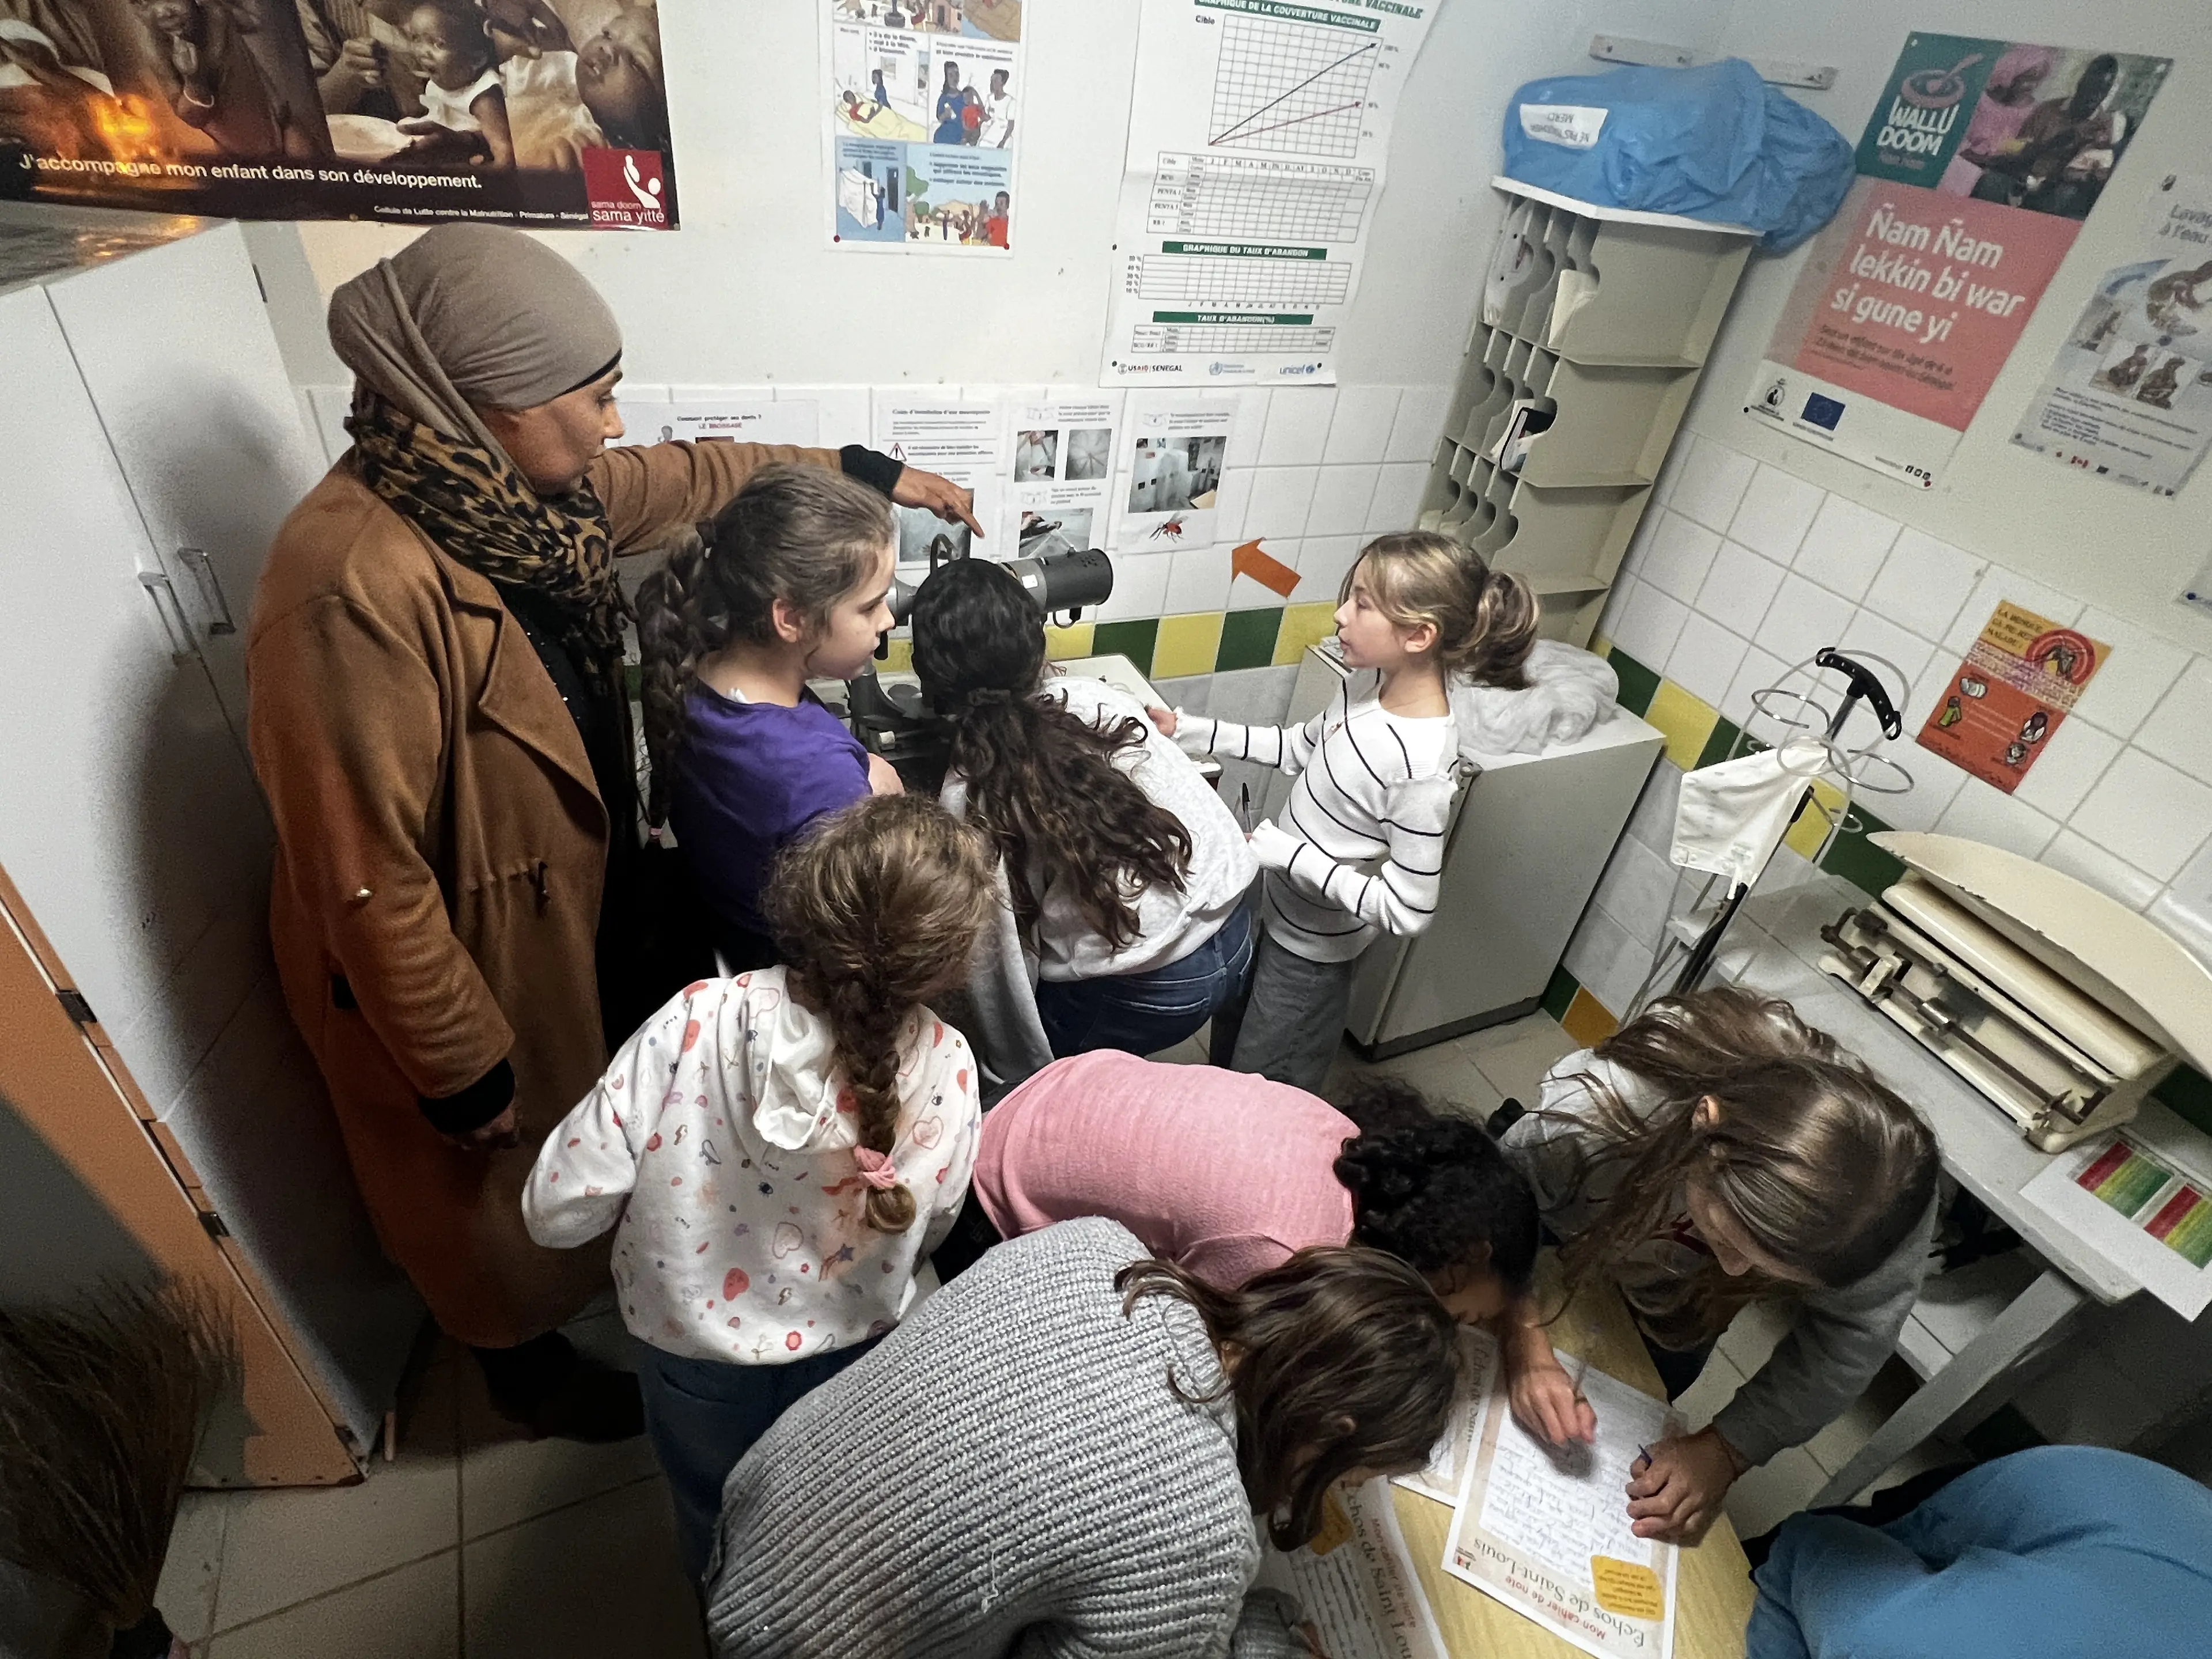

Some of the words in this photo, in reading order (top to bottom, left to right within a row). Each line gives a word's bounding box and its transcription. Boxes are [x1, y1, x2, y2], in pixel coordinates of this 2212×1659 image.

[1248, 2, 1260, 12] DE
[1261, 3, 1272, 12] LA
[1274, 5, 1328, 21] COUVERTURE
[1330, 14, 1376, 29] VACCINALE
[1888, 95, 1959, 134] WALLU
[1876, 125, 1944, 157] DOOM
[20, 153, 162, 177] J'accompagne
[165, 164, 208, 177] mon
[211, 164, 269, 180] enfant
[272, 166, 315, 180] dans
[318, 169, 350, 182] son
[353, 169, 483, 189] développement.
[591, 201, 615, 209] sama
[617, 200, 642, 210] doom
[592, 210, 632, 222] sama
[635, 207, 665, 226] yitté
[1866, 203, 1931, 251] Ñam
[1931, 218, 2004, 270] Ñam
[1183, 244, 1228, 253] GRAPHIQUE
[1229, 245, 1241, 253] DU
[1243, 247, 1263, 255] TAUX
[1264, 247, 1309, 257] D'ABANDON
[1849, 243, 1931, 293] lekkin
[1931, 265, 1969, 302] bi
[1965, 283, 2025, 317] war
[1831, 282, 1860, 313] si
[1852, 295, 1923, 334] gune
[1919, 311, 1958, 345] yi
[1152, 364, 1183, 372] SENEGAL
[1279, 364, 1305, 374] unicef
[1361, 1541, 1376, 1563] de
[1474, 1537, 1566, 1603] Saint-Louis
[1505, 1575, 1529, 1595] note
[1531, 1590, 1544, 1604] de
[1569, 1593, 1590, 1613] de
[1547, 1599, 1580, 1623] cahier
[1583, 1619, 1607, 1641] Mon
[1593, 1606, 1645, 1648] Échos
